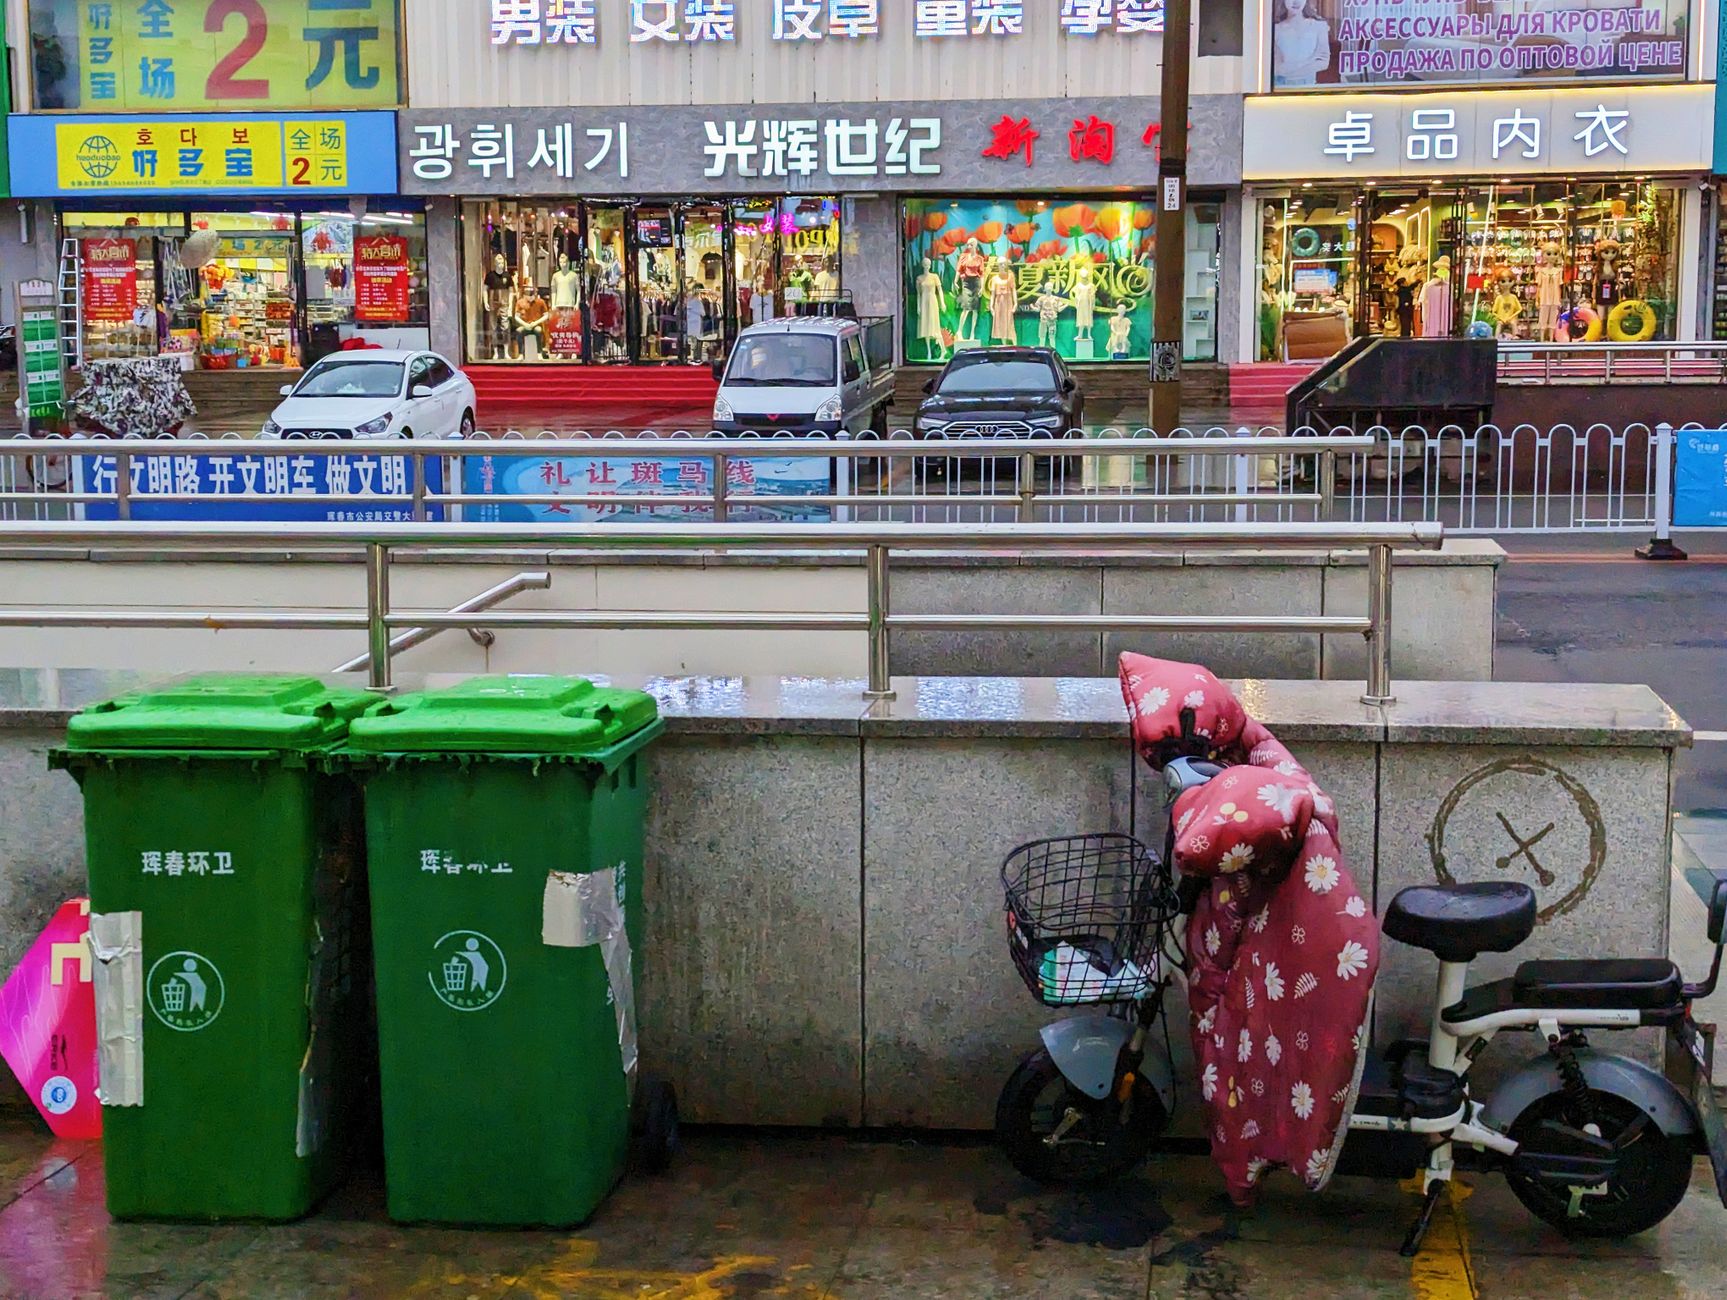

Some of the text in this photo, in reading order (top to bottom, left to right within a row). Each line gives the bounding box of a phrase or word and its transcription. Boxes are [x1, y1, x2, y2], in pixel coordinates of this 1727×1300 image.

[492, 0, 597, 45] 男装
[630, 0, 735, 42] 女装
[1338, 8, 1662, 41] АКСЕССУАРЫ ДЛЯ КРОВАТИ
[136, 0, 176, 100] 全场
[1338, 40, 1684, 79] ПРОДАЖА ПО ОПТОВОЙ ЦЕНЕ
[289, 127, 342, 151] 全场
[408, 121, 629, 181] 광휘세기
[702, 117, 942, 178] 光辉世纪
[1322, 103, 1631, 163] 卓品内衣
[92, 454, 432, 494] 行文明路 开文明车 做文明
[540, 460, 757, 486] 礼让斑马线
[141, 850, 235, 876] 珲春环卫
